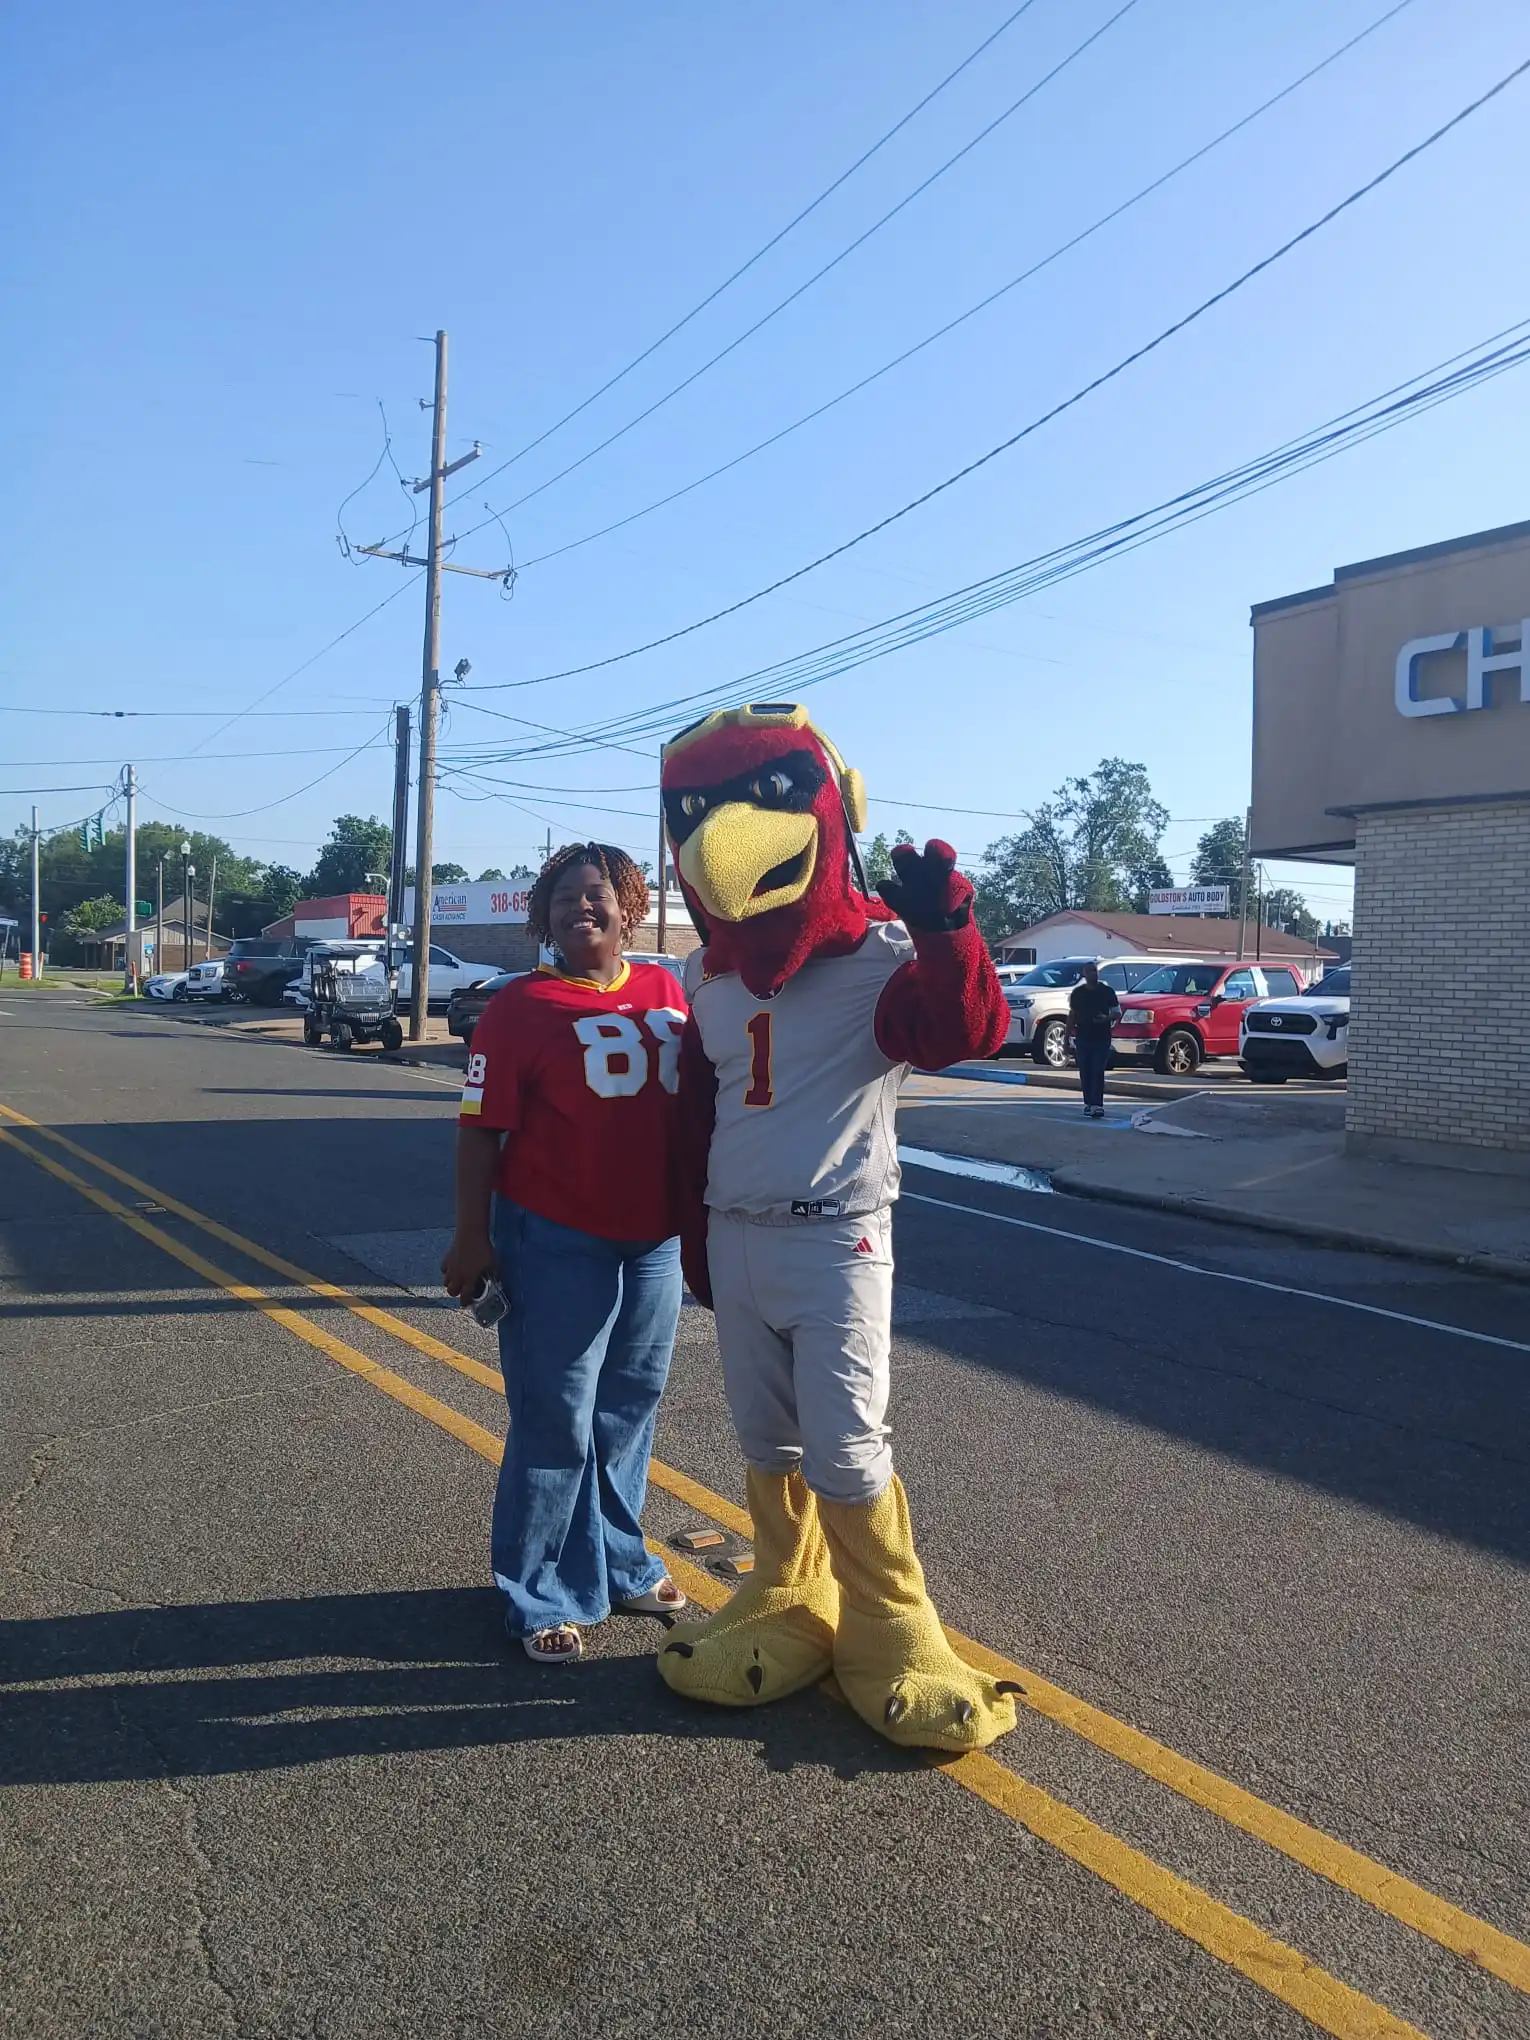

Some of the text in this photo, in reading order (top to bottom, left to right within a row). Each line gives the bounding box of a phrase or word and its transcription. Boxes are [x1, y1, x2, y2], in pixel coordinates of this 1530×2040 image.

[1395, 618, 1530, 718] CH
[432, 891, 467, 912] American
[1188, 891, 1206, 902] AUTO
[1206, 891, 1224, 901] BODY
[744, 1011, 774, 1109] 1
